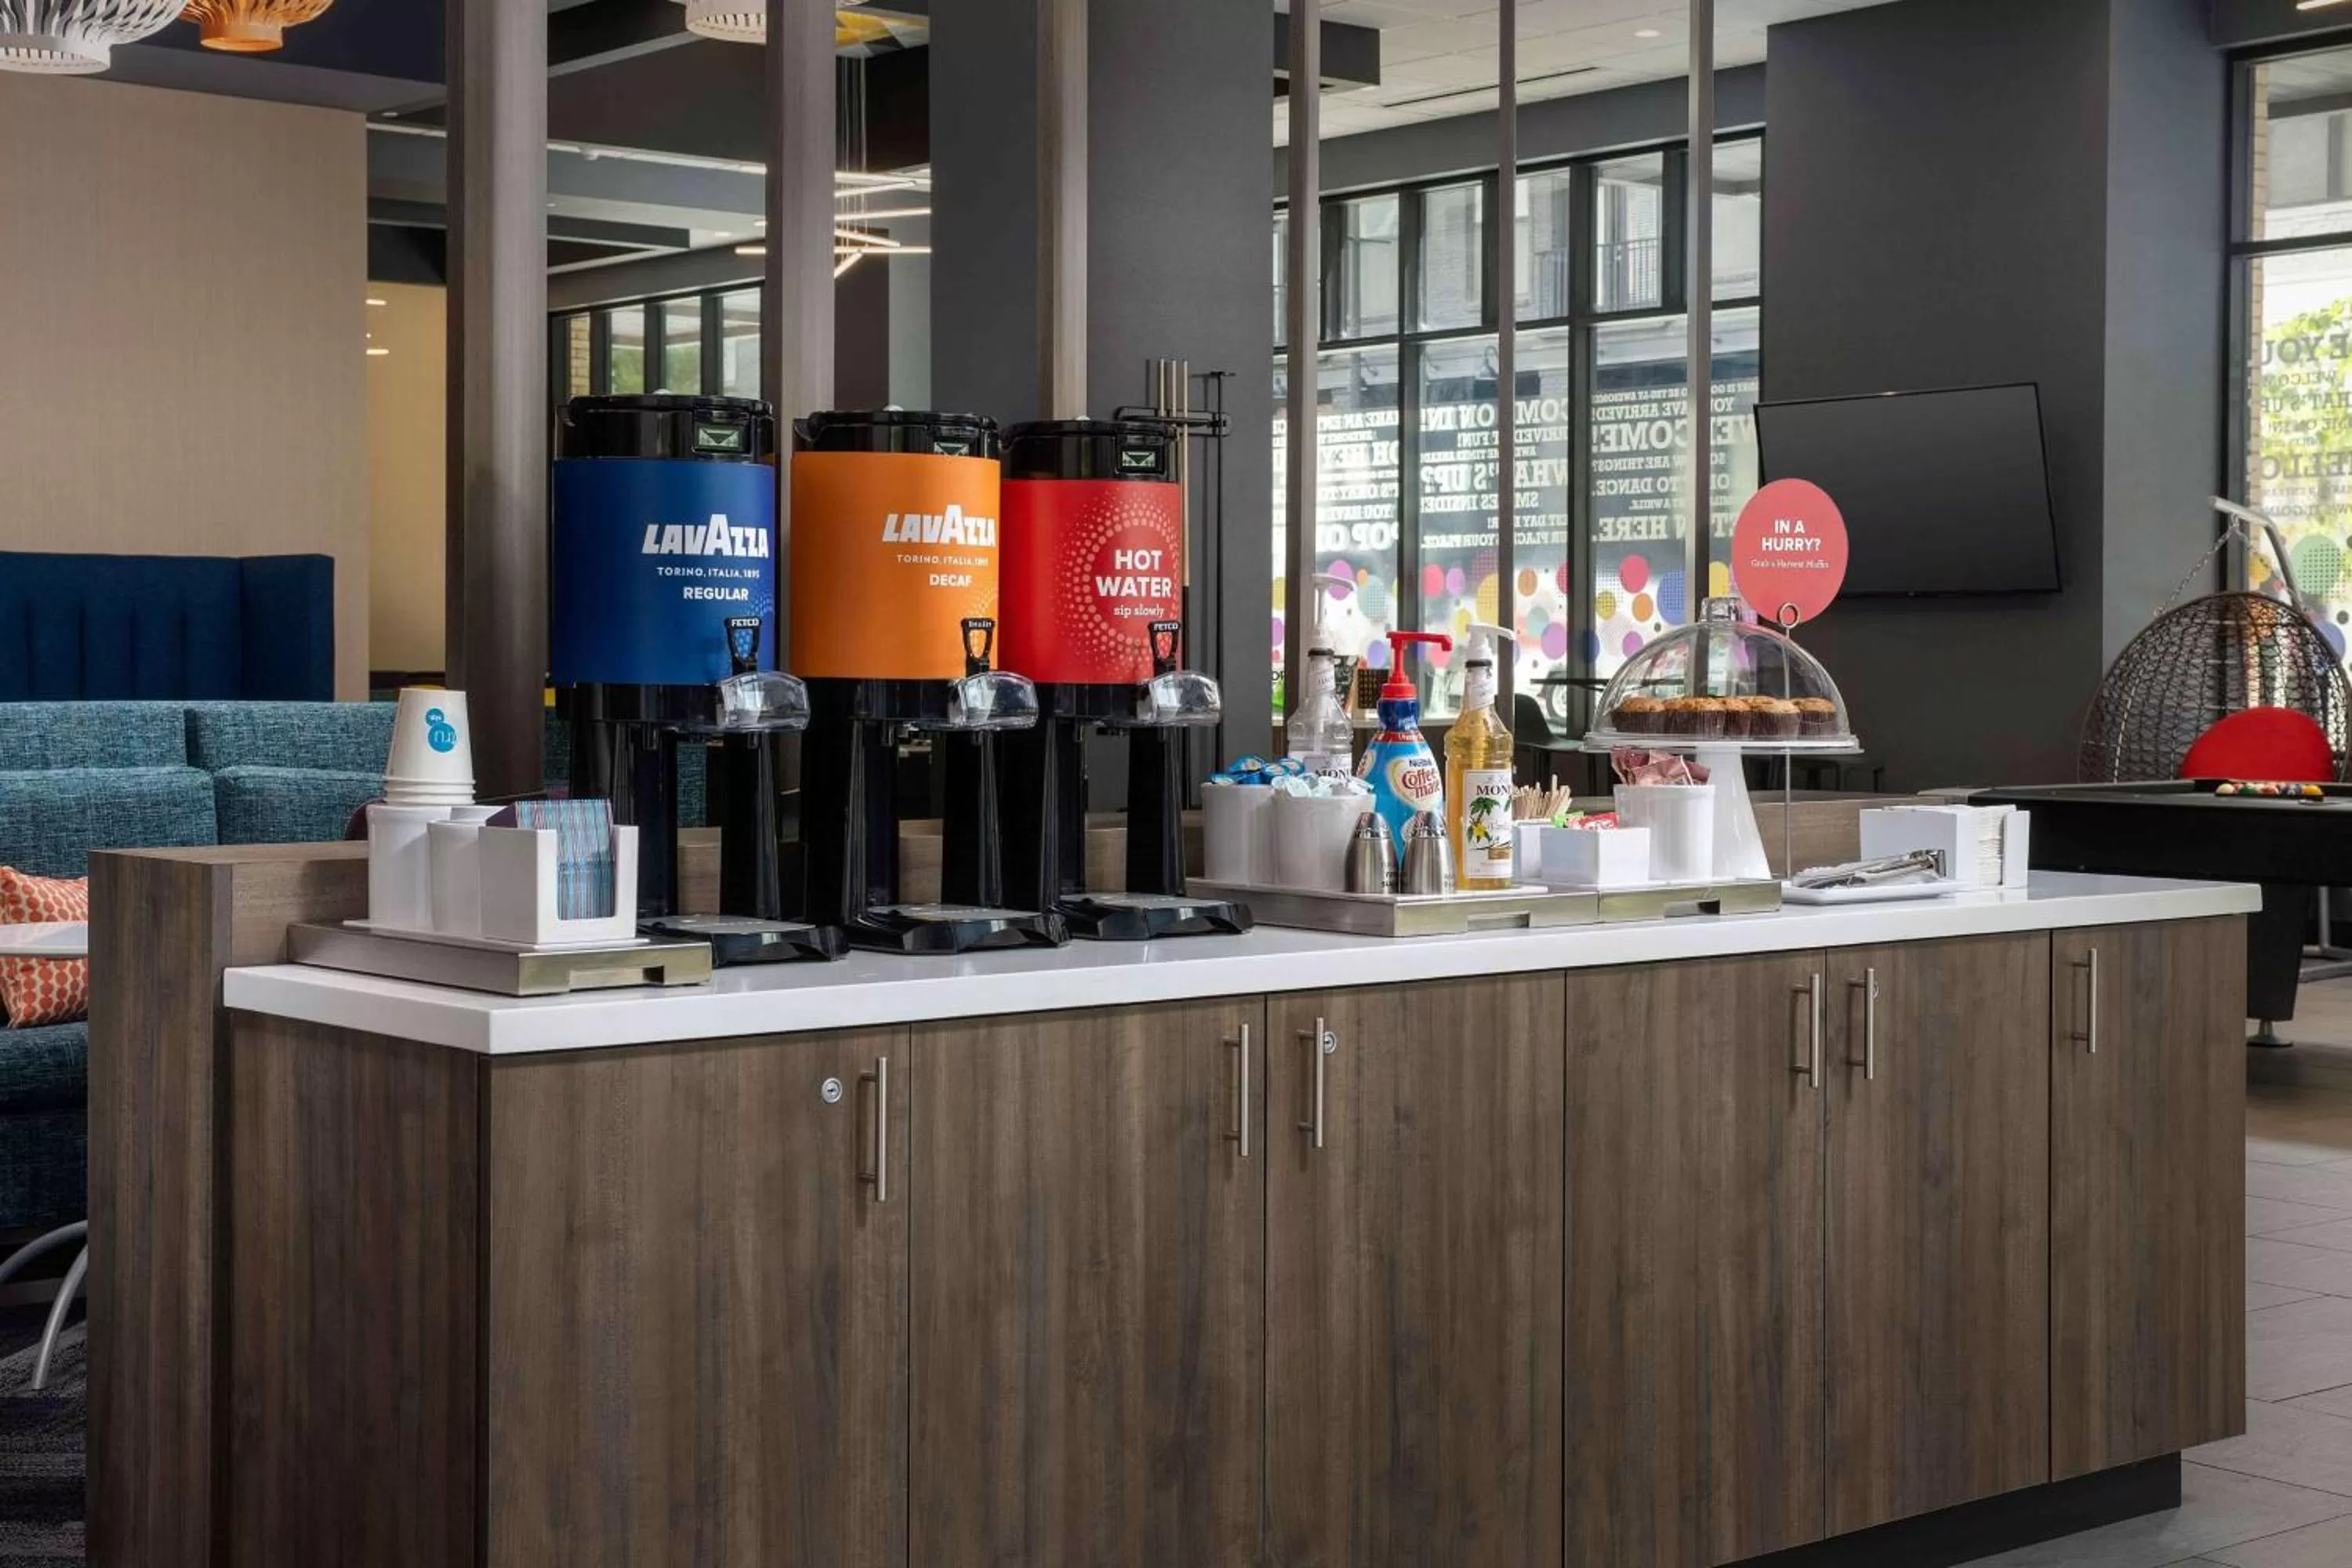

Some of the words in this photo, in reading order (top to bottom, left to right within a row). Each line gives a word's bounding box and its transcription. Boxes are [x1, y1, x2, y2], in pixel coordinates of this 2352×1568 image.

[882, 504, 996, 547] LAVAZZA
[1774, 520, 1790, 534] IN
[1794, 520, 1806, 534] A
[642, 514, 769, 558] LAVAZZA
[1761, 538, 1821, 552] HURRY?
[1115, 549, 1163, 572] HOT
[657, 567, 706, 578] TORINO,
[929, 574, 973, 587] DECAF
[1095, 576, 1173, 598] WATER
[683, 586, 750, 601] REGULAR
[1113, 604, 1131, 619] sip
[1134, 603, 1166, 619] slowly
[1476, 784, 1511, 797] MON
